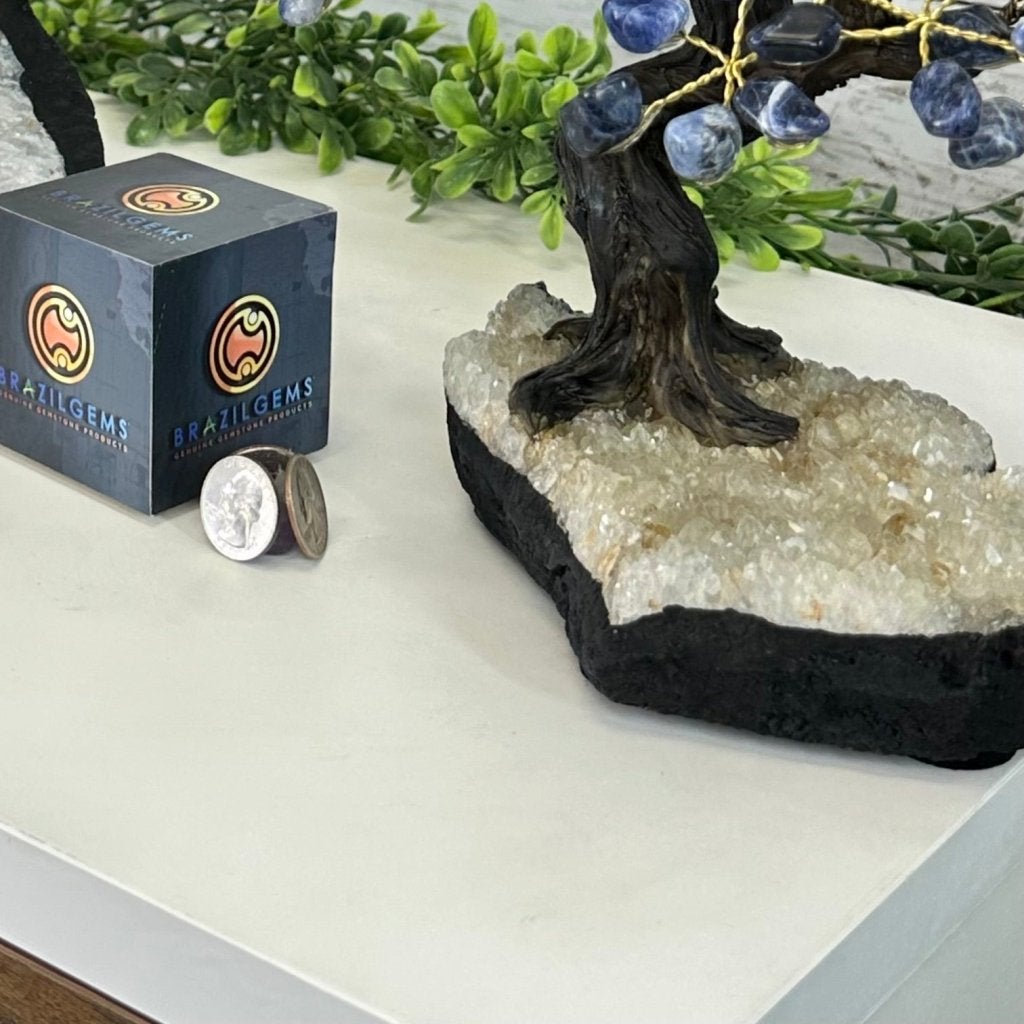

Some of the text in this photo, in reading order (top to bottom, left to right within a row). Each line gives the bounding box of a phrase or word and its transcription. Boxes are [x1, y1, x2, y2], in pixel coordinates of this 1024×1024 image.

[49, 189, 194, 242] BRAZILGEMS
[36, 405, 79, 432] GEMSTONE
[83, 427, 128, 453] PRODUCTS
[174, 376, 314, 448] BRAZILGEMS
[218, 419, 264, 443] GEMSTONE
[267, 400, 313, 423] PRODUCTS
